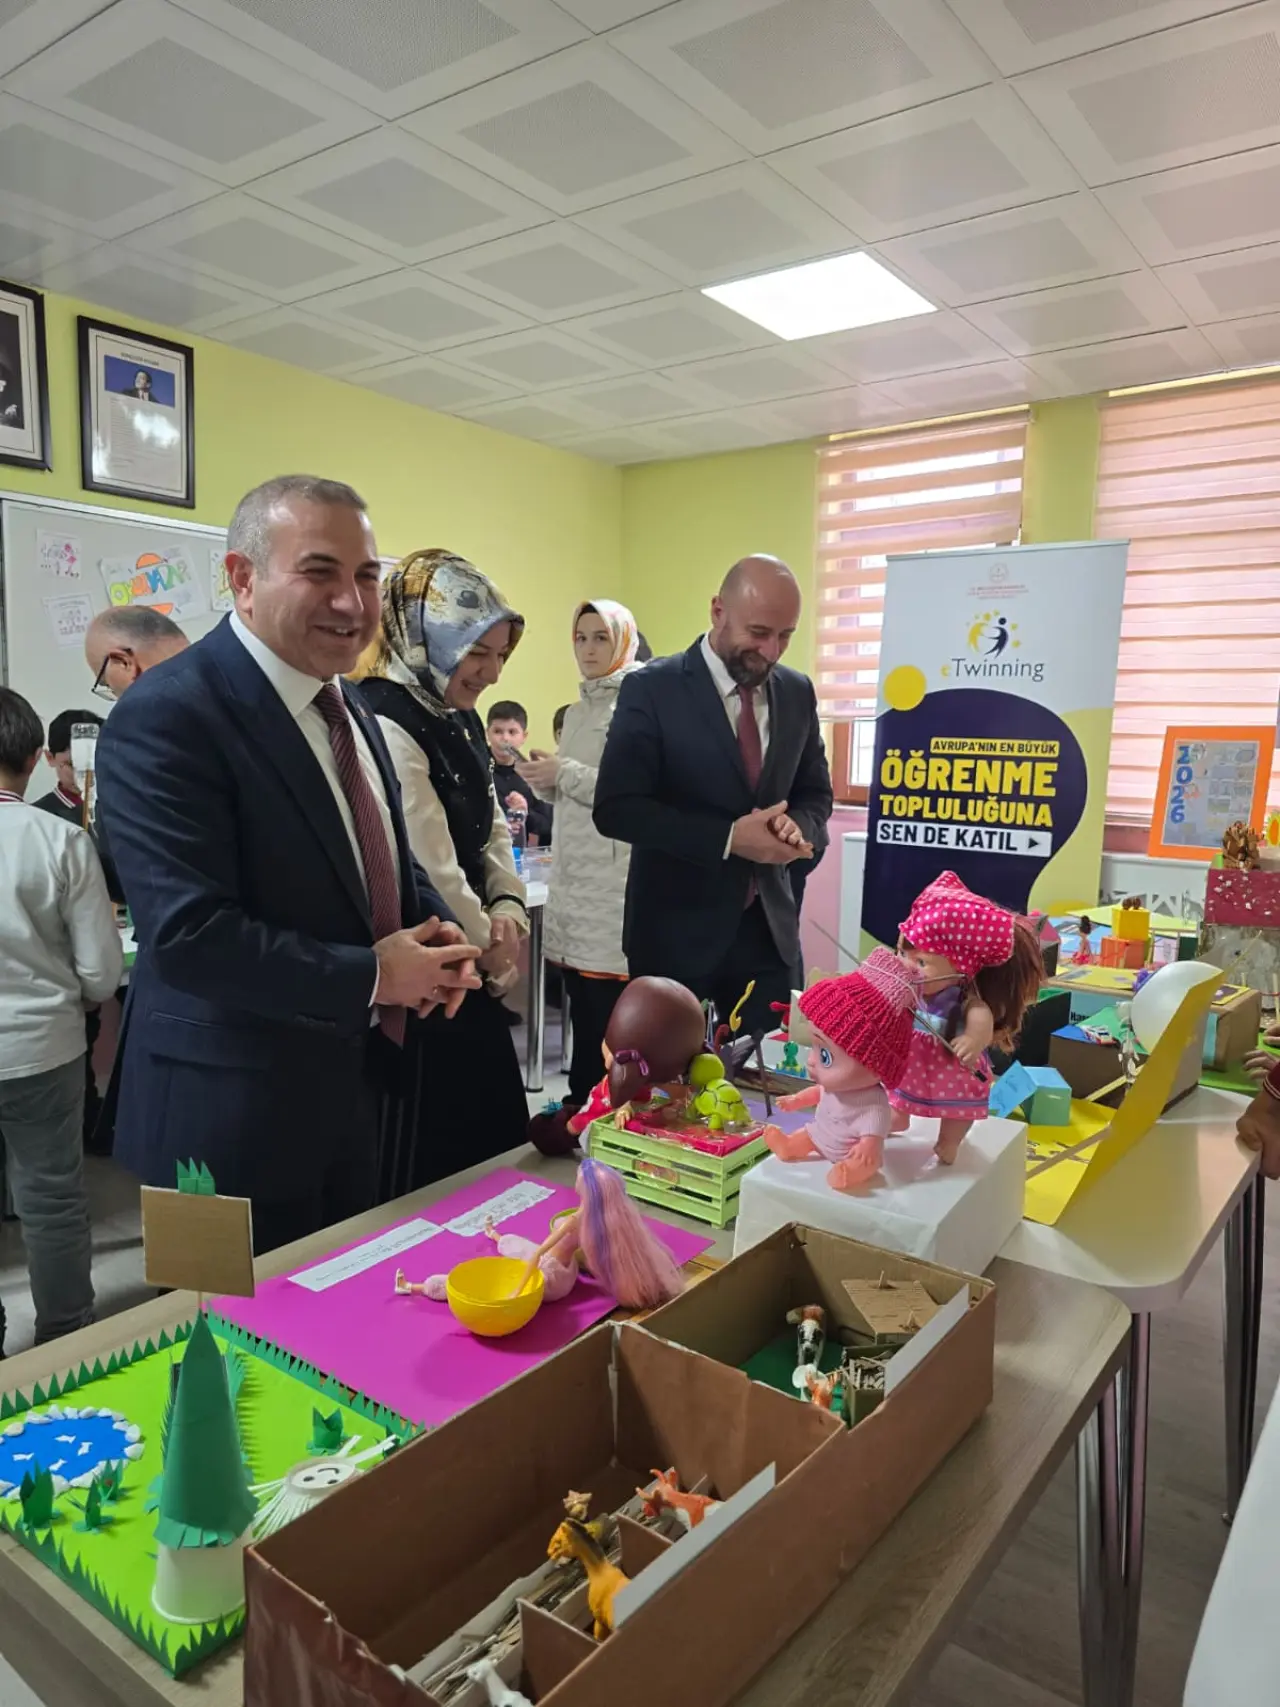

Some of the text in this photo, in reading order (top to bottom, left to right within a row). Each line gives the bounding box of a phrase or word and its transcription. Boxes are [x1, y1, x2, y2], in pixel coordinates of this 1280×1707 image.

[941, 658, 1045, 682] eTwinning
[932, 740, 1057, 754] AVRUPA'NIN EN BÜYÜK
[880, 749, 1059, 797] ÖĞRENME
[879, 794, 1053, 827] TOPLULUĞUNA
[880, 823, 1018, 851] SEN DE KATIL
